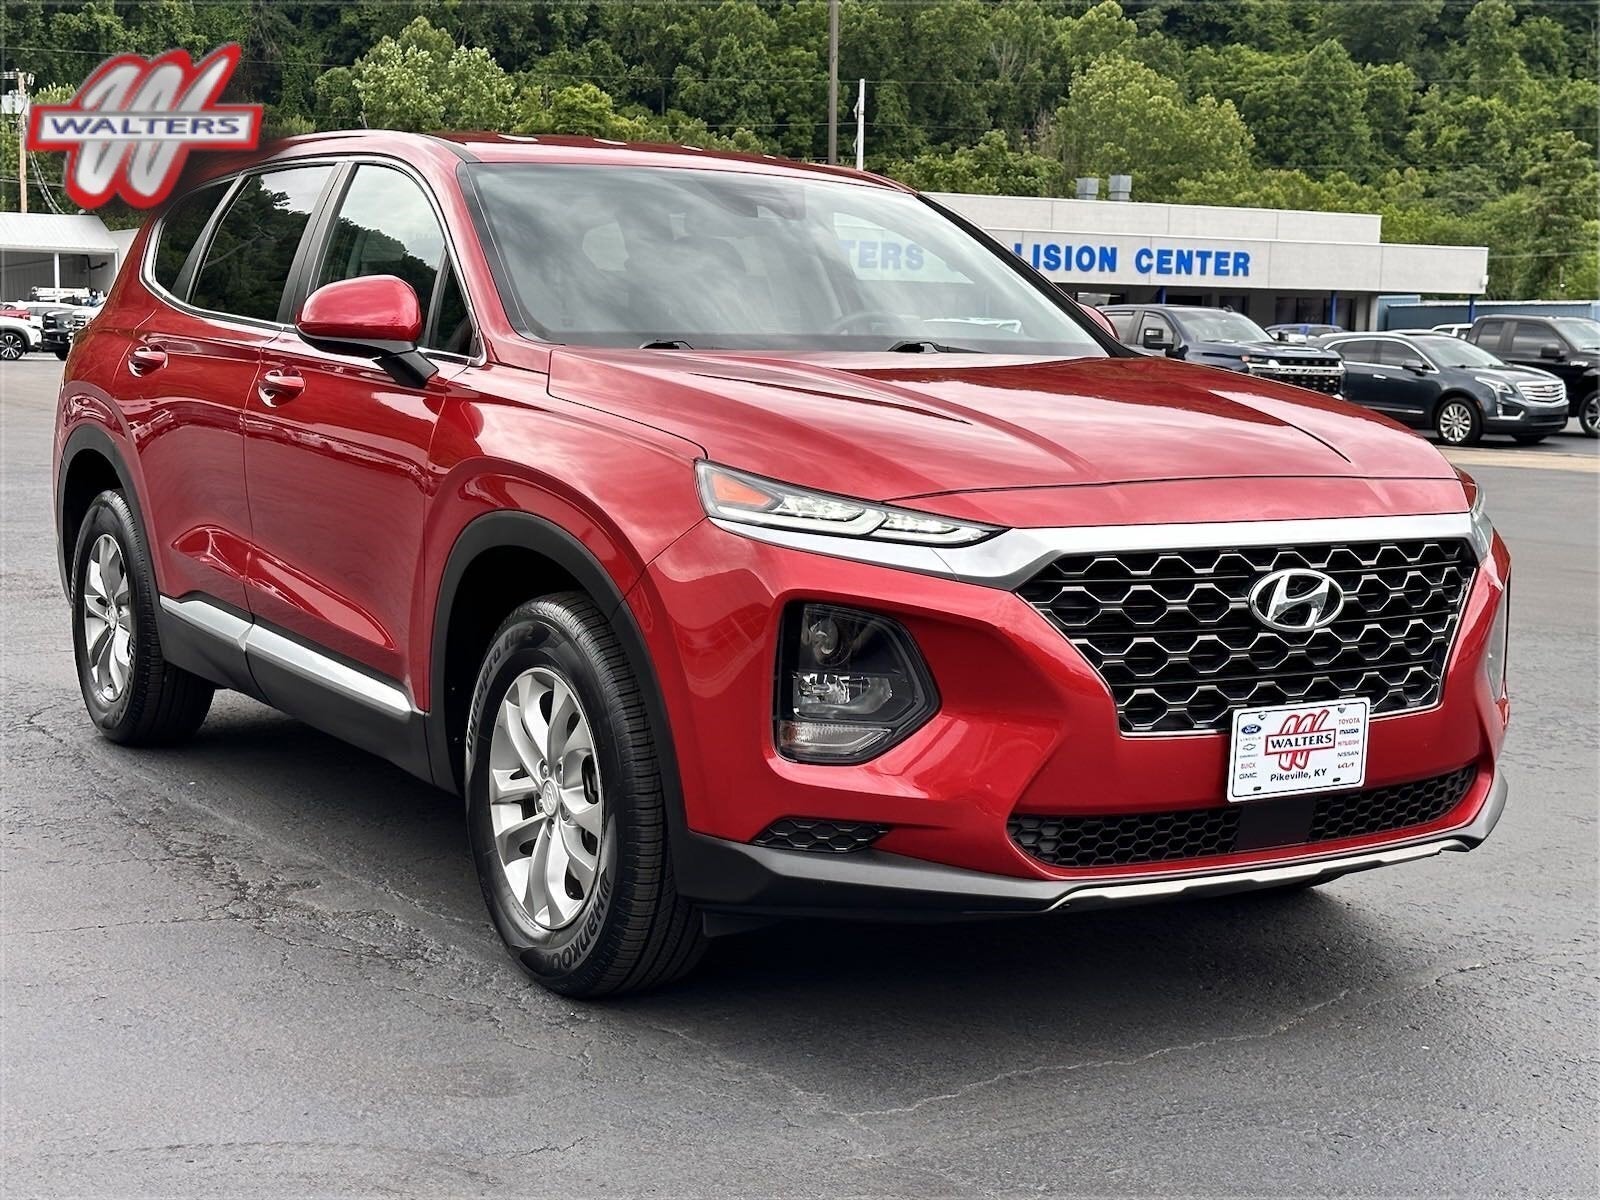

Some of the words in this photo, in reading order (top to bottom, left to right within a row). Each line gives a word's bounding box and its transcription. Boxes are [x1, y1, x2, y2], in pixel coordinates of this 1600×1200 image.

[1135, 248, 1250, 277] CENTER
[1338, 717, 1360, 725] TOYOTA
[1270, 733, 1332, 749] WALTERS
[1270, 770, 1311, 782] Pikeville,
[1314, 768, 1327, 777] KY
